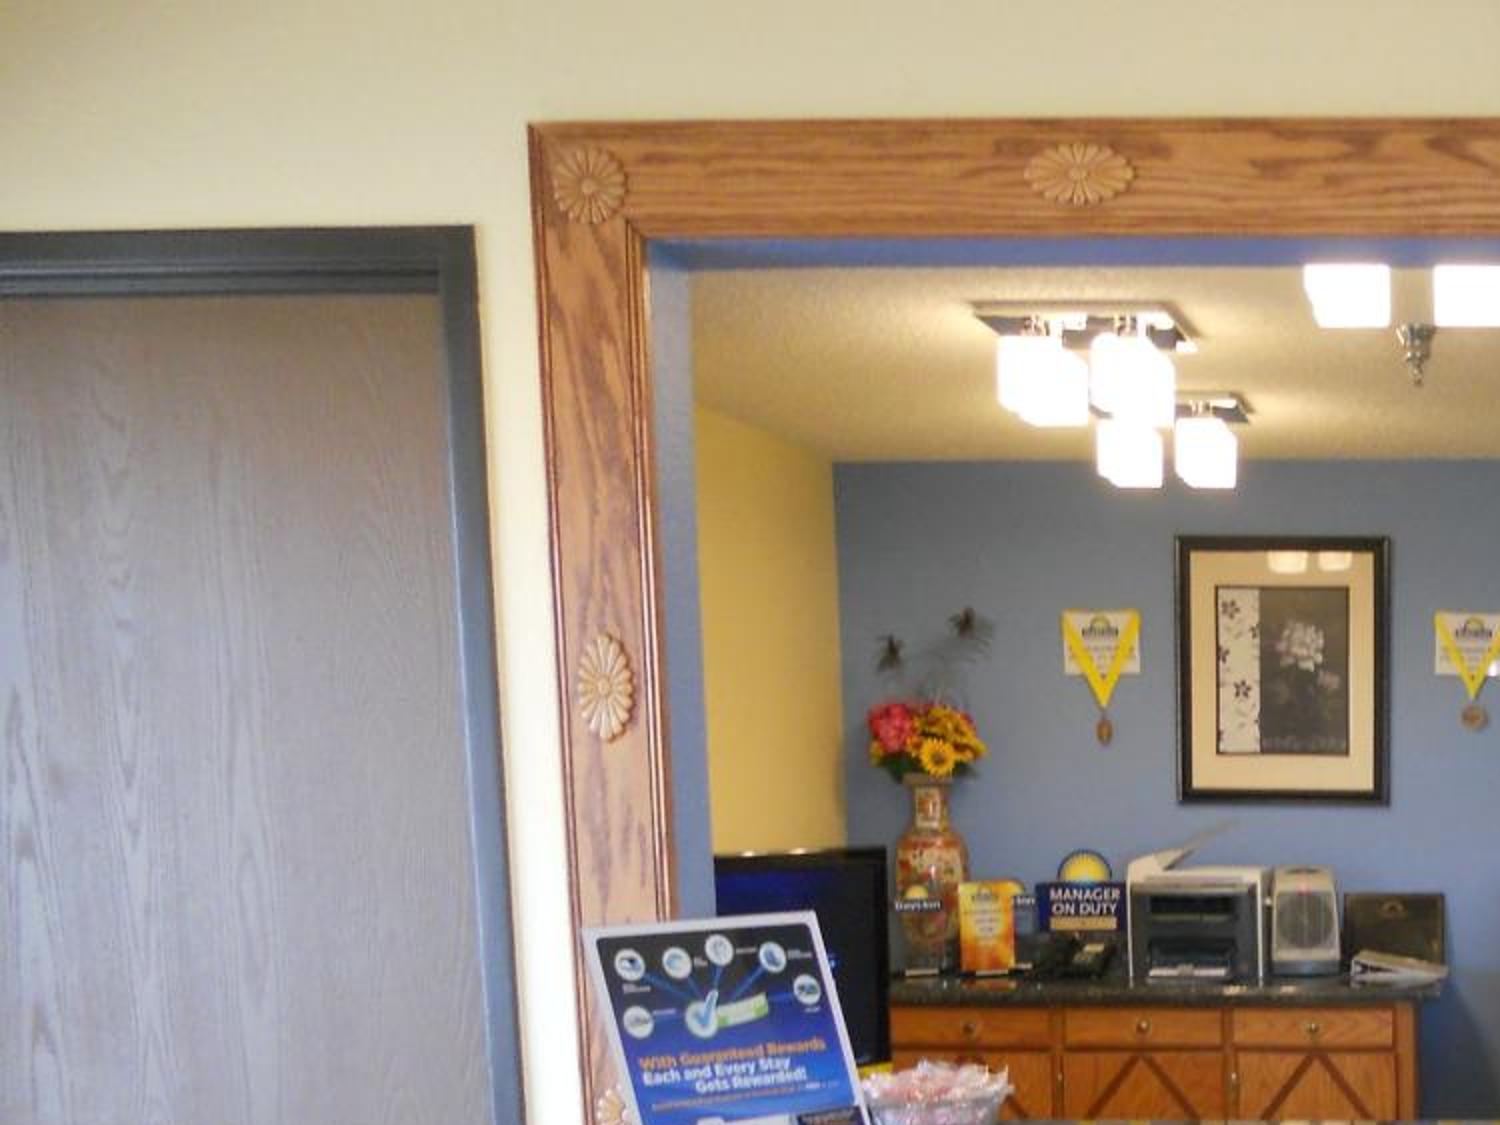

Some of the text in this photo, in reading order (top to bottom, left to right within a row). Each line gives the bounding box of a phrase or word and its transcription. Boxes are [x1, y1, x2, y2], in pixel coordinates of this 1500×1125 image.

[1049, 887, 1120, 900] MANAGER
[1051, 902, 1117, 915] ON DUTY
[642, 1056, 792, 1086] Each and Every Stay
[696, 1077, 731, 1093] Gets
